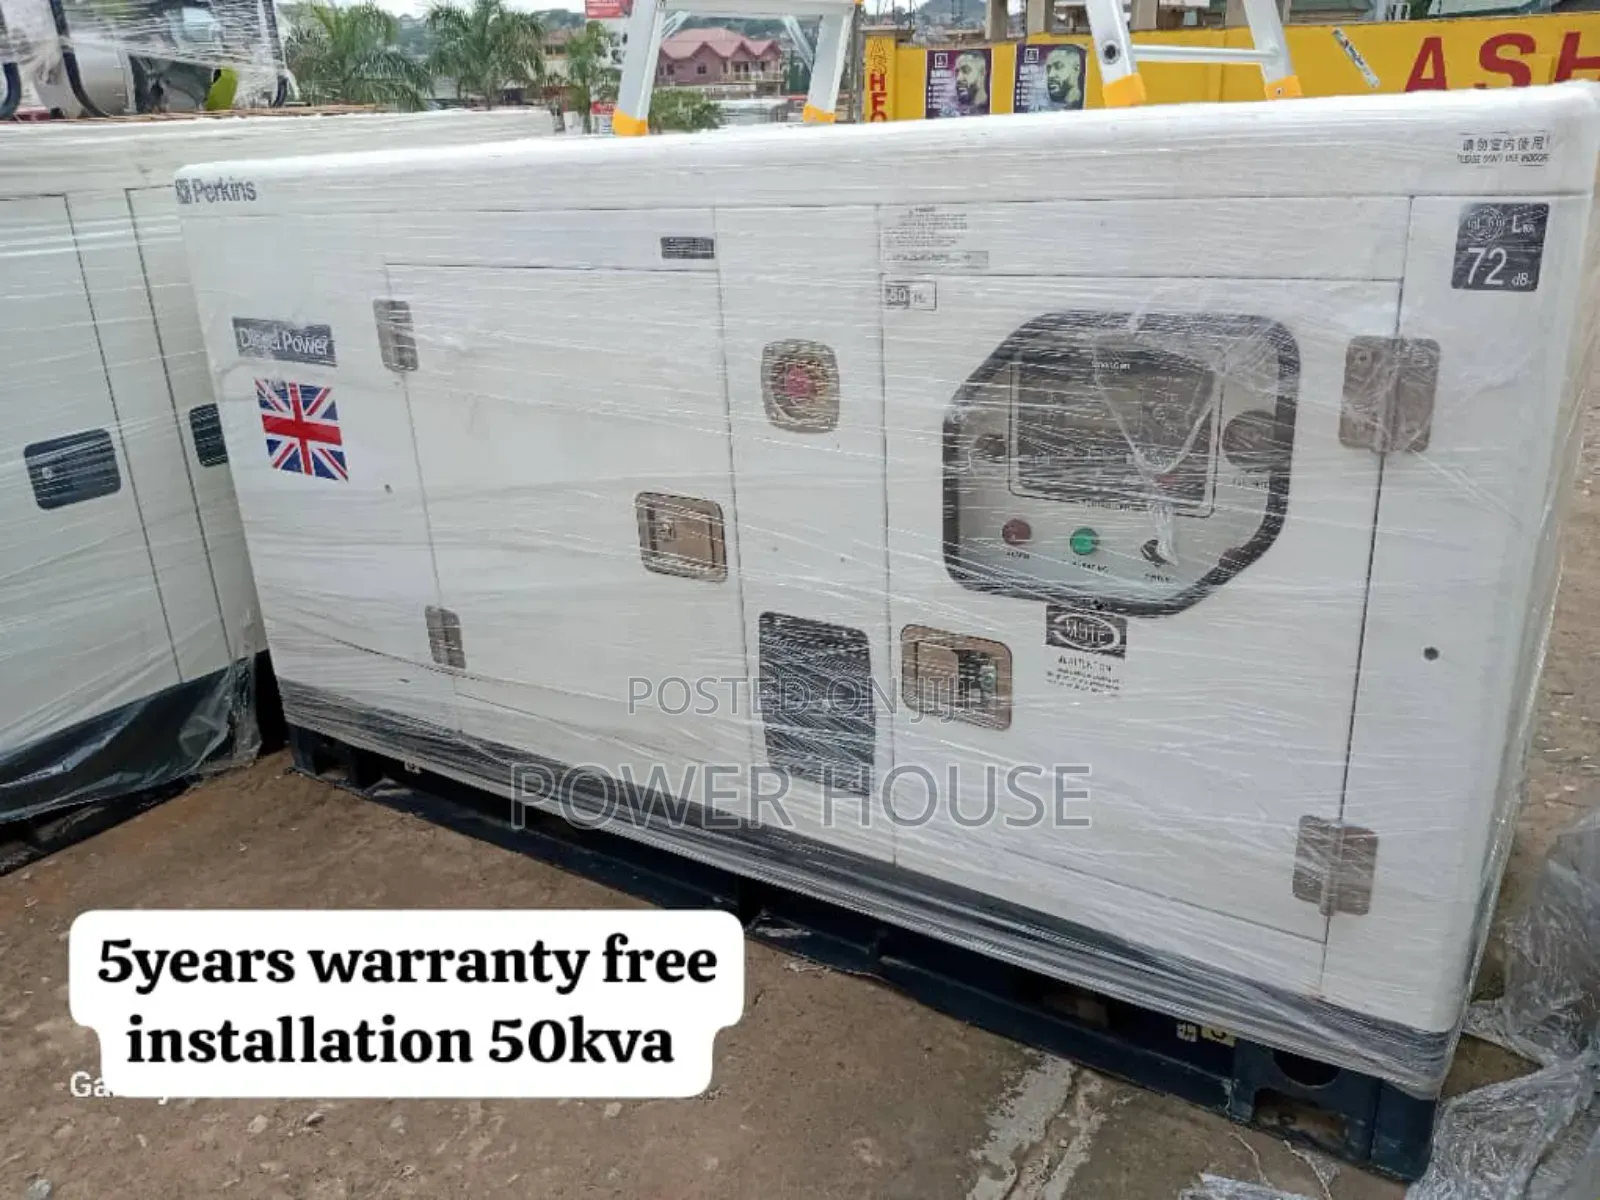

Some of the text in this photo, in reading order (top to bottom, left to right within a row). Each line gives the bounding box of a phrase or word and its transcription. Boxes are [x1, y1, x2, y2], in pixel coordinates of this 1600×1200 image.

[192, 177, 257, 203] Perkins
[1467, 247, 1507, 285] 72
[282, 331, 330, 356] Power
